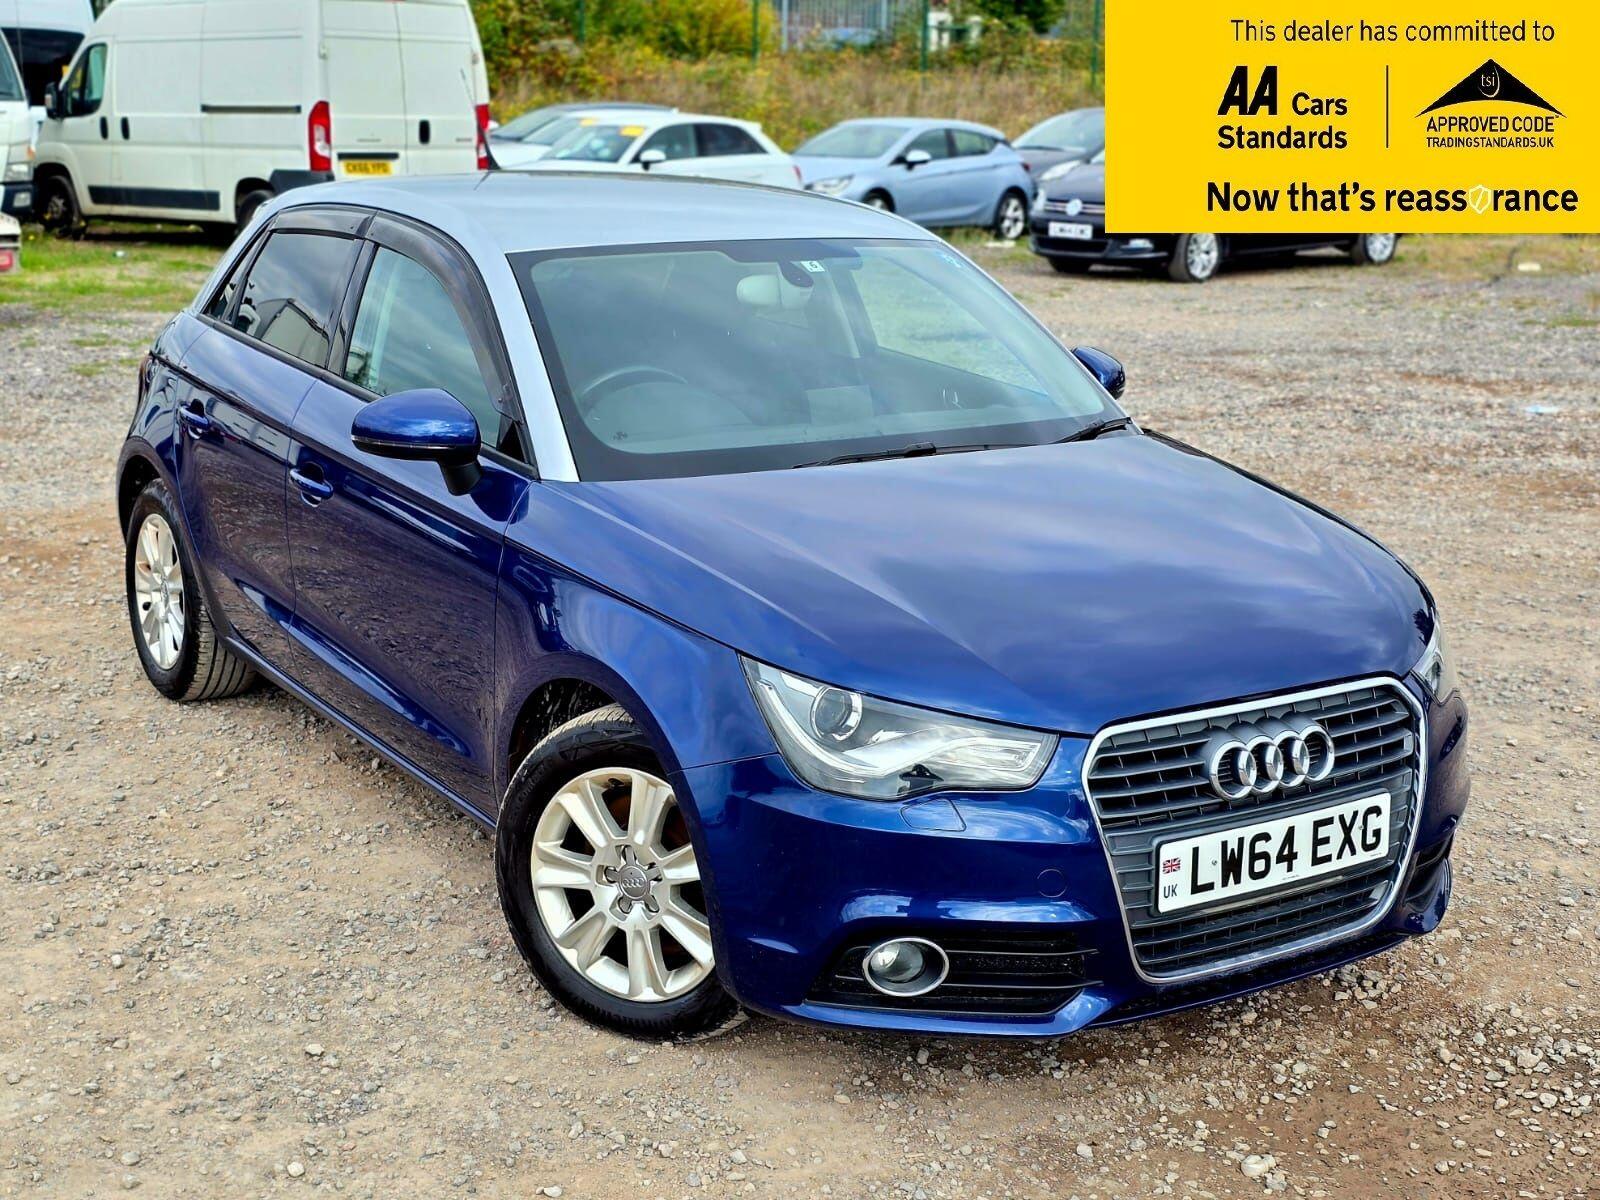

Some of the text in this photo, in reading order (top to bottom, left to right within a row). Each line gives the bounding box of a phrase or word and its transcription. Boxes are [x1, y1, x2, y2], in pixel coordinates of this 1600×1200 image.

[1191, 806, 1382, 895] LW64 EXG
[1163, 884, 1178, 899] UK
